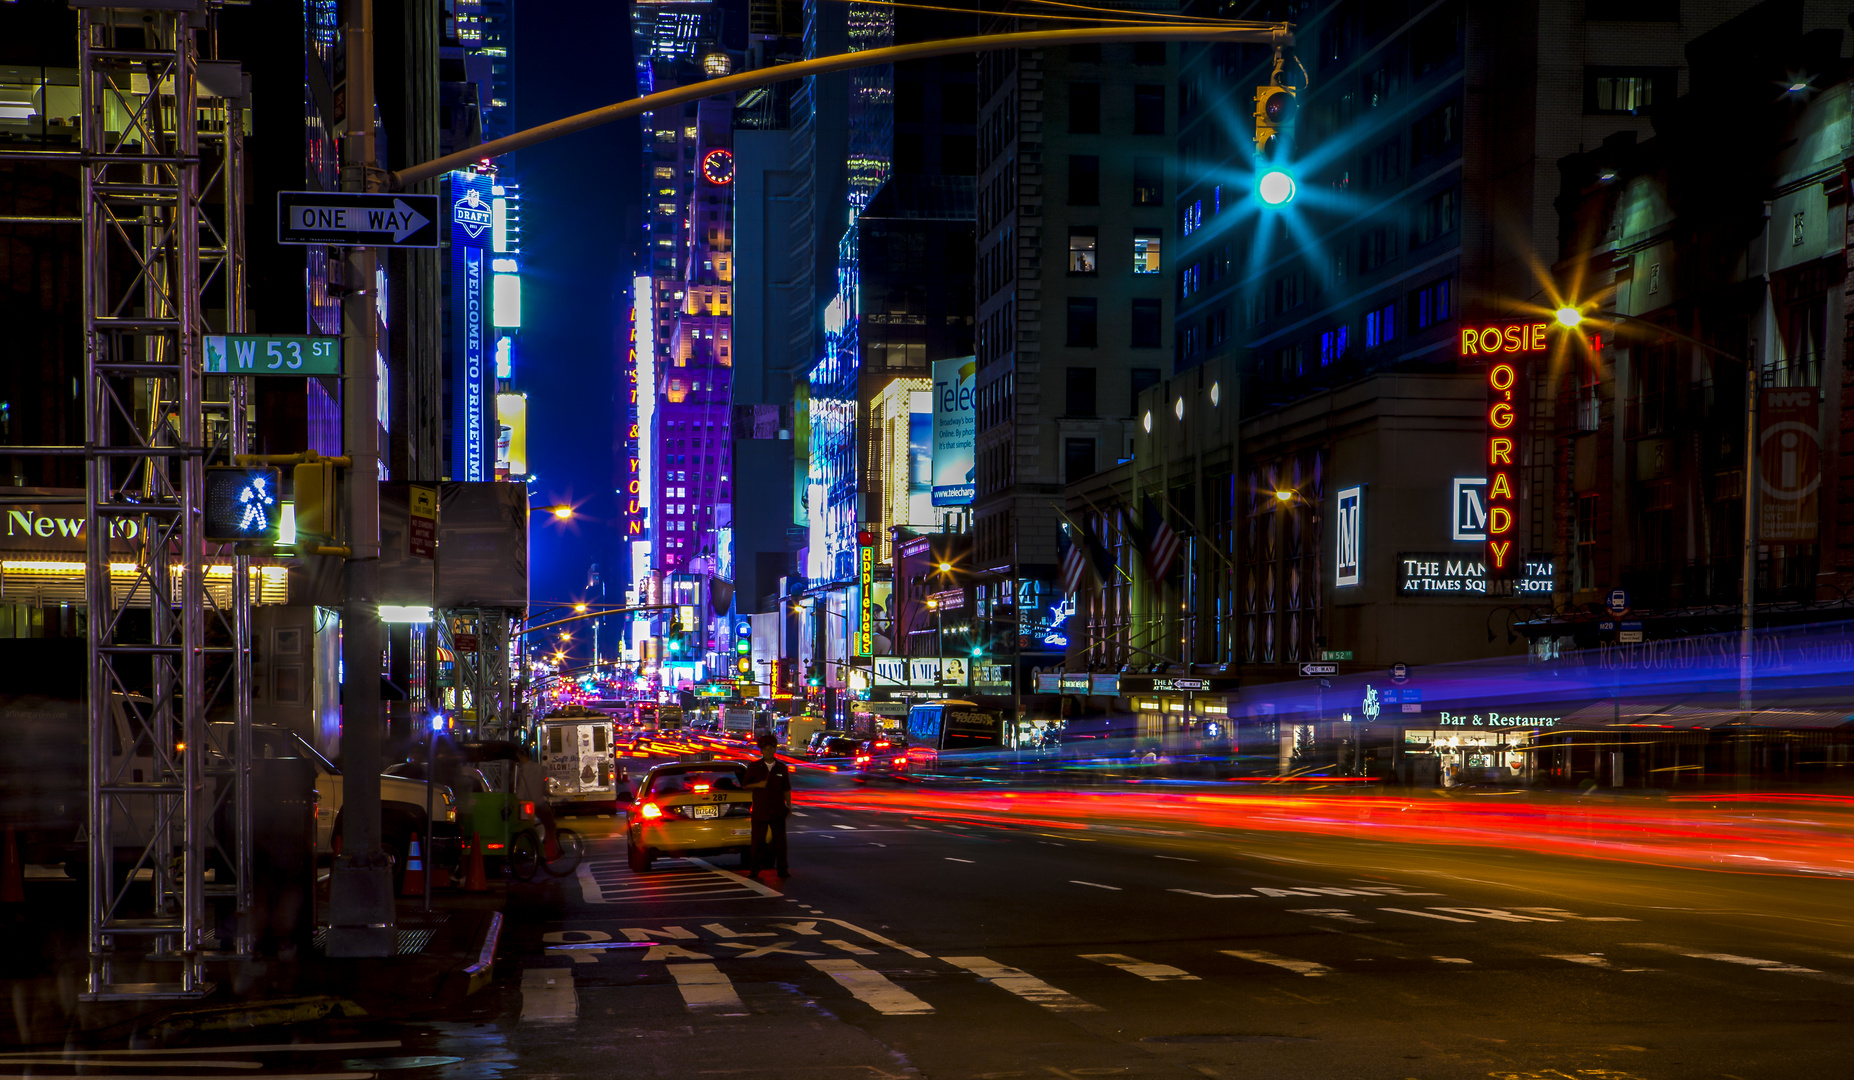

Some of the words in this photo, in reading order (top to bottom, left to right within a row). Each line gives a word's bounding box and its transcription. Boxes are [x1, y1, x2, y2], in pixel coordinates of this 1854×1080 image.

[302, 208, 347, 229] ONE
[367, 210, 415, 231] WAY
[457, 209, 490, 223] DRAFT
[468, 260, 480, 351] WELCOME
[1461, 322, 1548, 356] ROSIE
[233, 340, 257, 370] W
[266, 340, 304, 370] 53
[311, 341, 333, 357] ST
[469, 354, 480, 379] TO
[1768, 392, 1812, 408] NYC
[939, 418, 965, 427] Broadway's
[629, 424, 639, 438] &
[946, 440, 956, 450] that
[956, 440, 973, 451] simple.
[1488, 364, 1515, 569] O'GRADY
[628, 458, 641, 535] YOUN
[1763, 503, 1797, 513] Official
[6, 509, 86, 538] New
[1763, 512, 1784, 521] NYC
[1763, 520, 1817, 530] Information
[1763, 529, 1795, 539] Center
[1403, 560, 1440, 576] THE
[1444, 560, 1554, 577] MANTAN
[1403, 580, 1421, 591] AT
[1421, 579, 1462, 591] TIMES
[1520, 580, 1553, 591] HOTE
[1486, 579, 1513, 596] BAR
[1599, 622, 1614, 630] M20
[1328, 651, 1334, 660] W
[1335, 651, 1345, 660] 52
[1599, 638, 1639, 671] ROSIE
[1719, 632, 1787, 670] SAOON
[1798, 639, 1853, 664] SEAFOOD
[1152, 678, 1167, 686] THE
[1439, 711, 1467, 726] Bar
[1471, 714, 1484, 726] &
[712, 794, 728, 802] 287
[541, 921, 823, 944] ONLY
[543, 938, 880, 964] TAXI
